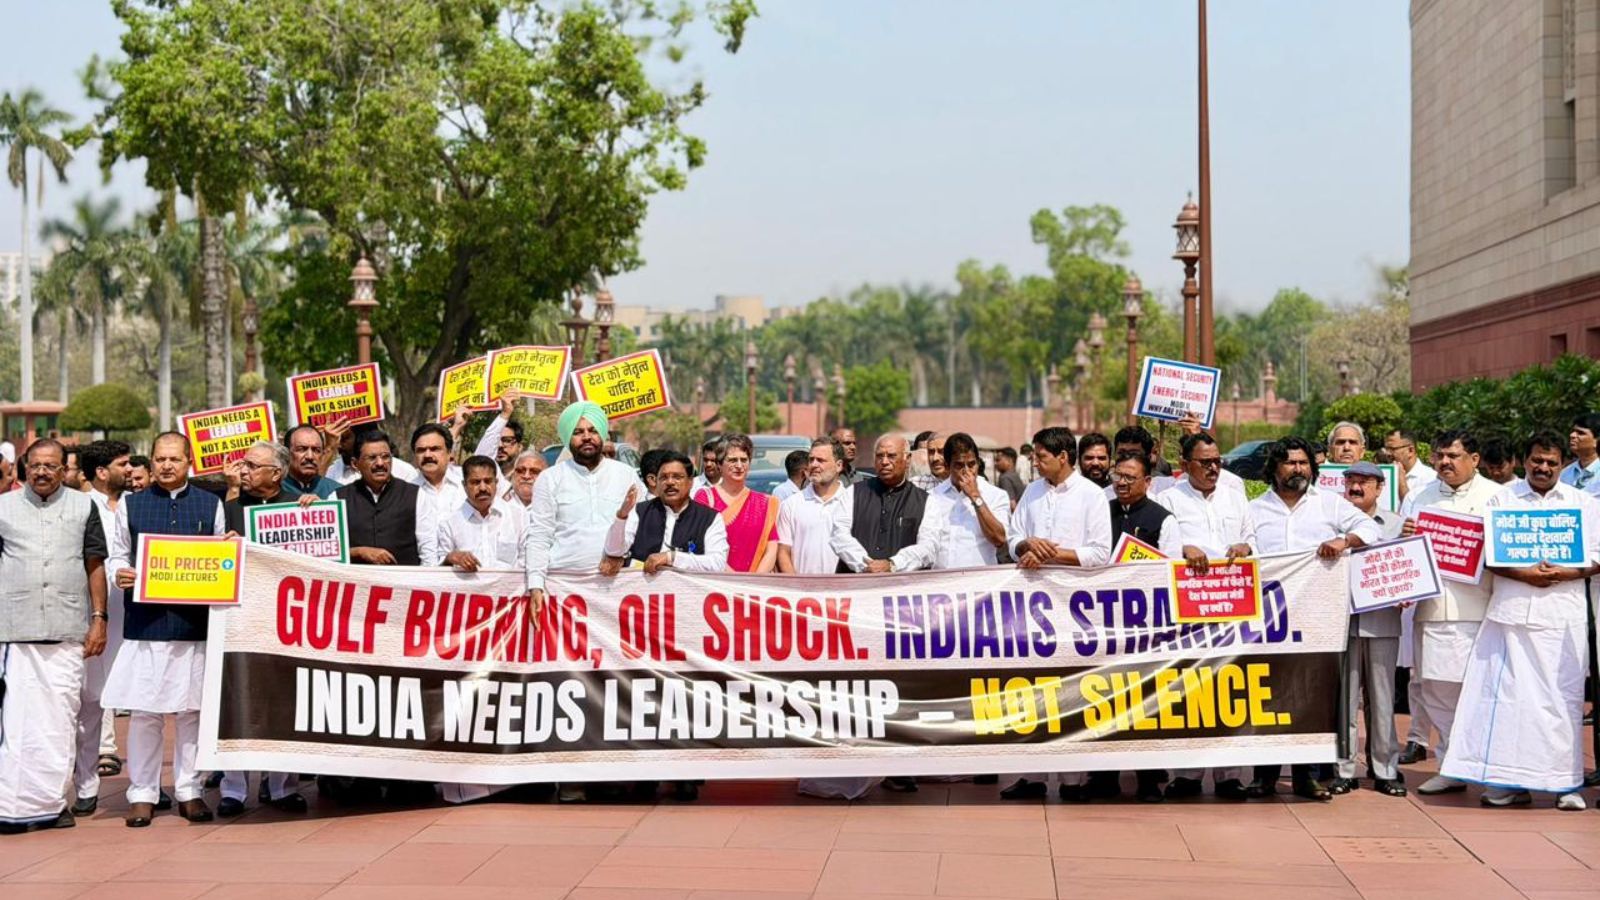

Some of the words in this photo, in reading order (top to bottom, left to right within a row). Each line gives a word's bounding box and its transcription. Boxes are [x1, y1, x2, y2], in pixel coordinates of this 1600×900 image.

[302, 378, 328, 389] INDIA
[330, 372, 359, 384] NEEDS
[360, 370, 366, 379] A
[1153, 366, 1184, 380] NATIONAL
[318, 384, 354, 398] LEADER
[1152, 386, 1178, 398] ENERGY
[308, 403, 326, 414] NOT
[329, 402, 336, 410] A
[338, 396, 366, 408] SILENT
[193, 416, 220, 428] INDIA
[222, 410, 252, 422] NEEDS
[253, 409, 260, 418] A
[210, 422, 248, 438] LEADER
[201, 442, 219, 454] NOT
[222, 440, 229, 450] A
[1318, 474, 1338, 486] देश
[258, 512, 298, 530] INDIA
[302, 510, 336, 526] NEED
[1496, 514, 1516, 528] मोदी
[1518, 514, 1529, 528] जी
[1530, 516, 1547, 531] कुछ
[1500, 533, 1513, 544] 46
[1514, 532, 1538, 544] लाख
[150, 556, 170, 570] OIL
[175, 557, 220, 570] PRICES
[150, 572, 174, 580] MODI
[176, 572, 218, 582] LECTURES
[276, 576, 392, 654] GULF
[404, 589, 603, 669] BURNING,
[618, 594, 687, 662] OIL
[702, 592, 868, 662] SHOCK.
[883, 591, 1057, 660] INDIANS
[294, 667, 426, 741] INDIA
[443, 679, 586, 744] NEEDS
[603, 677, 900, 741] LEADERSHIP
[970, 676, 1062, 736] NOT
[1080, 663, 1292, 732] SILENCE.
